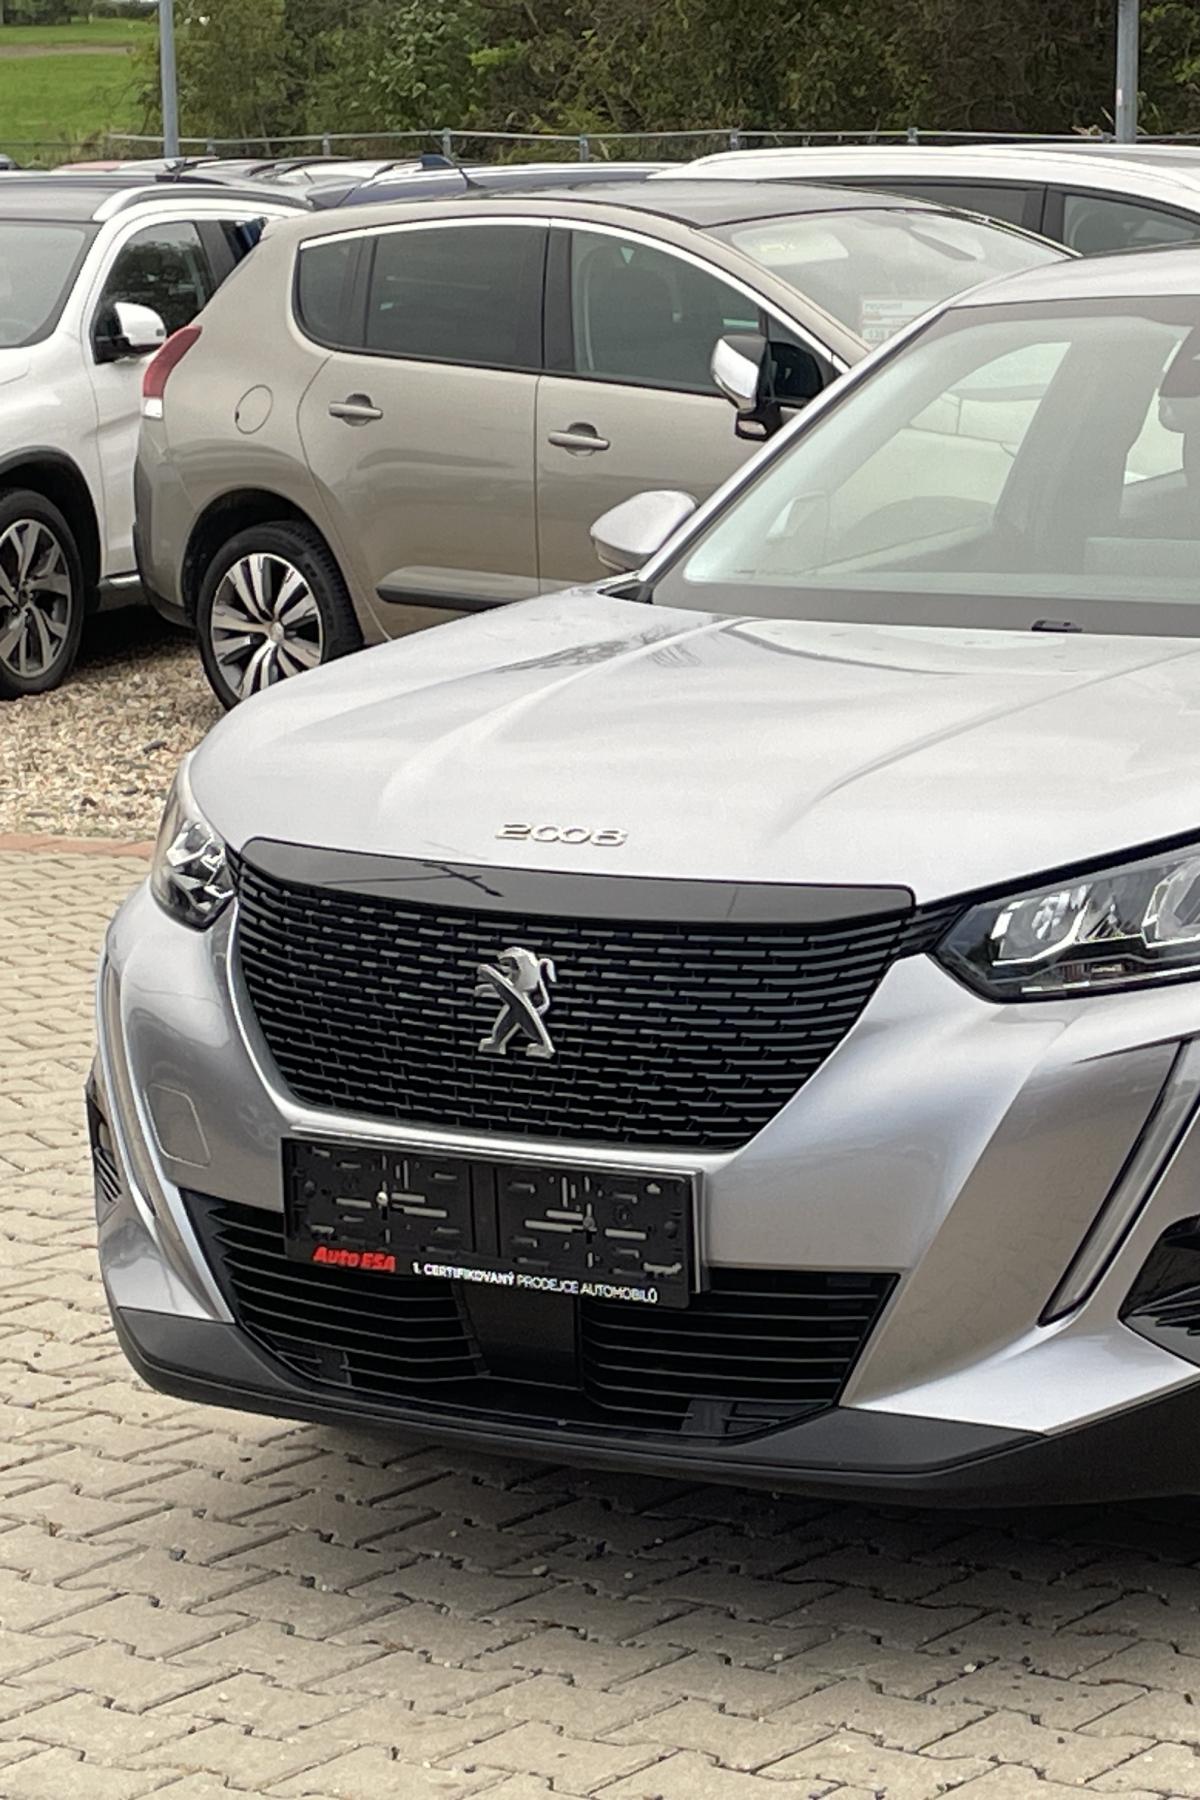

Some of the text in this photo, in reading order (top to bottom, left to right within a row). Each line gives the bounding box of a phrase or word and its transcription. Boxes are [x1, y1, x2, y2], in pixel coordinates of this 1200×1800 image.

[495, 822, 628, 847] 2008
[313, 1246, 396, 1273] Auto ESA
[412, 1262, 658, 1304] 1. CERTIFIKOVANÝ PRODEJCE AUTOMOBILŮ
